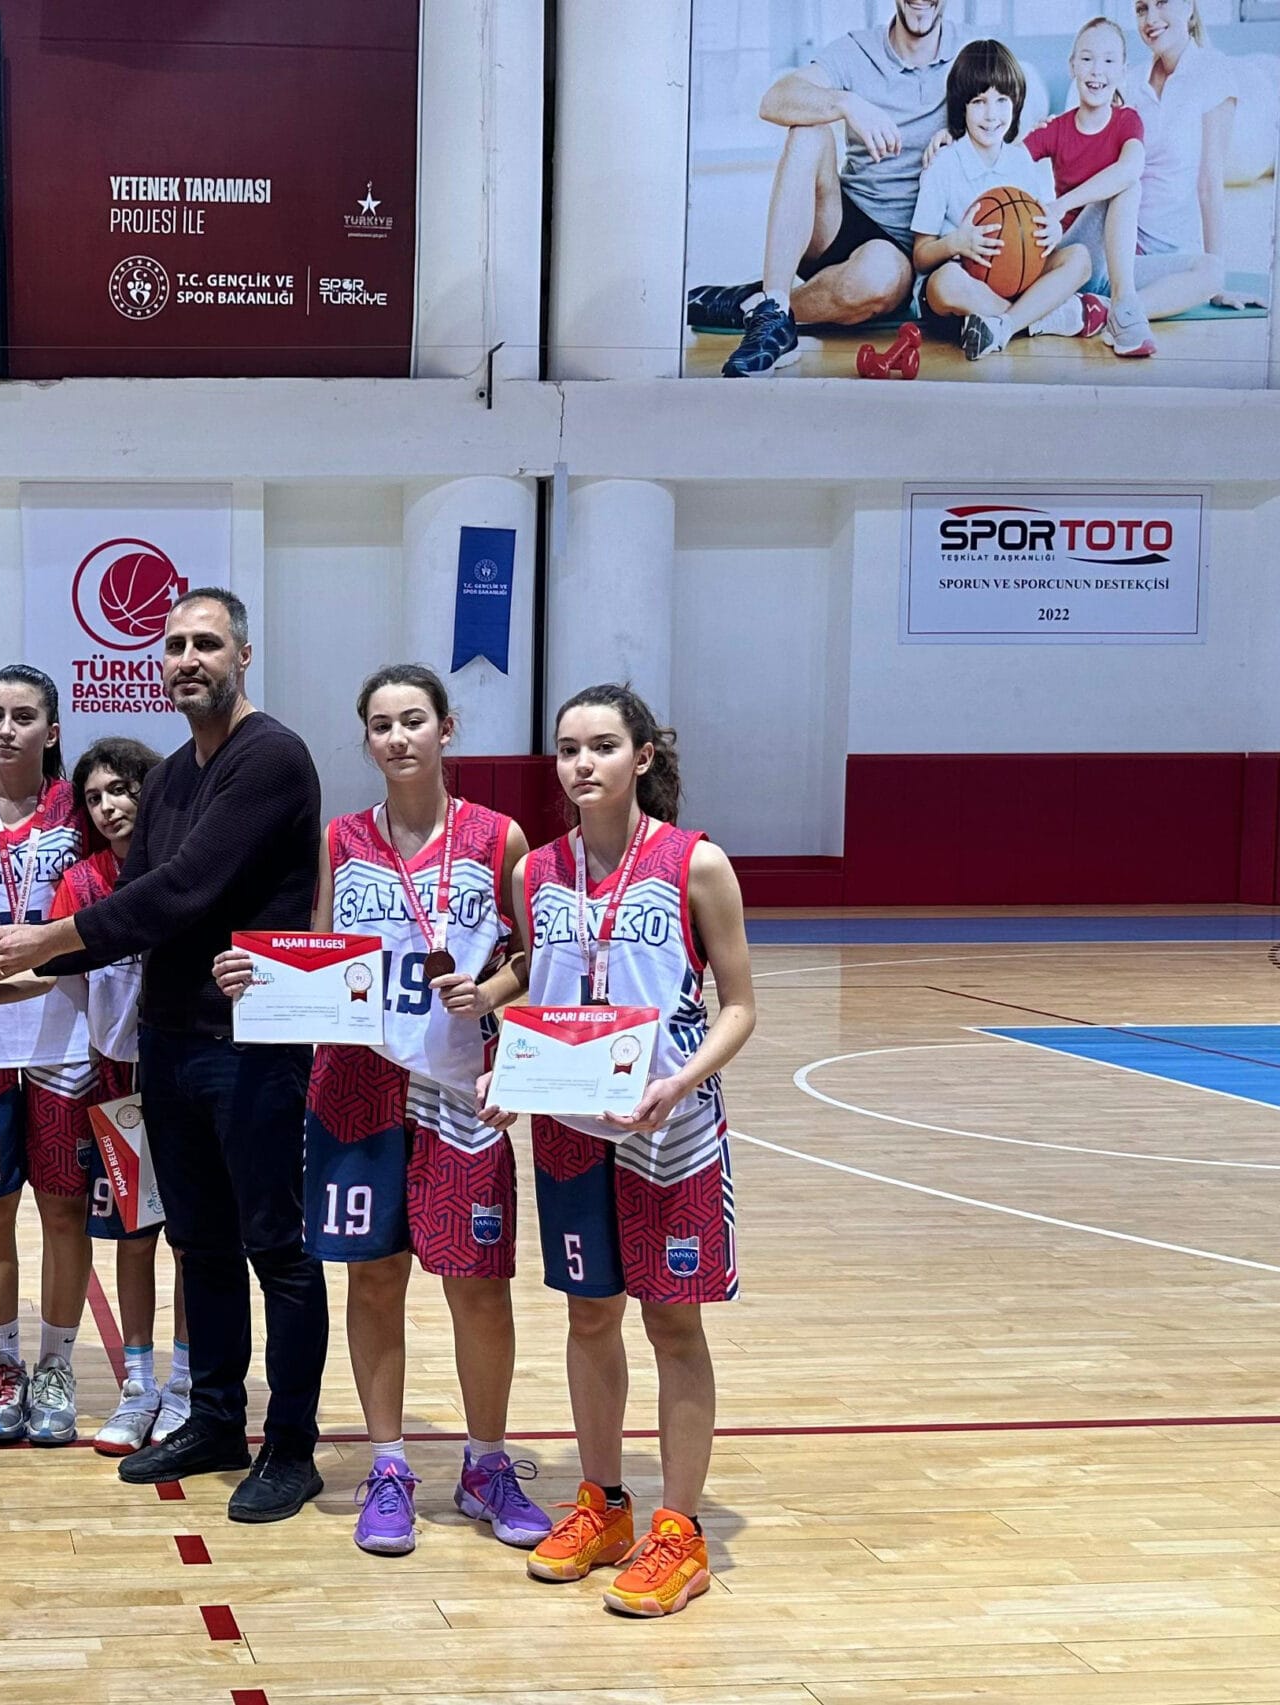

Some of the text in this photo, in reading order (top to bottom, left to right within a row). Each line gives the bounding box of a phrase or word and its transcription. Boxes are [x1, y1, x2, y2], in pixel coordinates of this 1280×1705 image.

[110, 176, 271, 204] YETENEK TARAMASI
[110, 206, 206, 235] PROJESİ İLE
[177, 272, 294, 290] T.C. GENÇLİK VE
[319, 278, 364, 291] SPOR
[176, 289, 294, 306] SPOR BAKANLIĞI
[319, 289, 388, 306] TÜRKİYE
[941, 552, 1056, 563] TEŞKİLAT BAŞKANLIĞI
[938, 578, 1170, 592] SPORUN VE SPORCUNUN DESTEKÇİSİ
[1037, 608, 1070, 621] 2022
[72, 700, 176, 713] FEDERASYON
[340, 883, 484, 928] SANKO
[534, 903, 670, 948] SANKO
[272, 938, 346, 950] BAŞARI BELGESİ
[542, 1010, 617, 1023] BAŞARI BELGESİ
[100, 1135, 129, 1197] BAŞARI BELGESİ
[91, 1177, 114, 1218] 9
[322, 1183, 373, 1236] 19
[474, 1218, 503, 1227] SANKO
[563, 1233, 584, 1281] 5
[669, 1252, 698, 1261] SANKO
